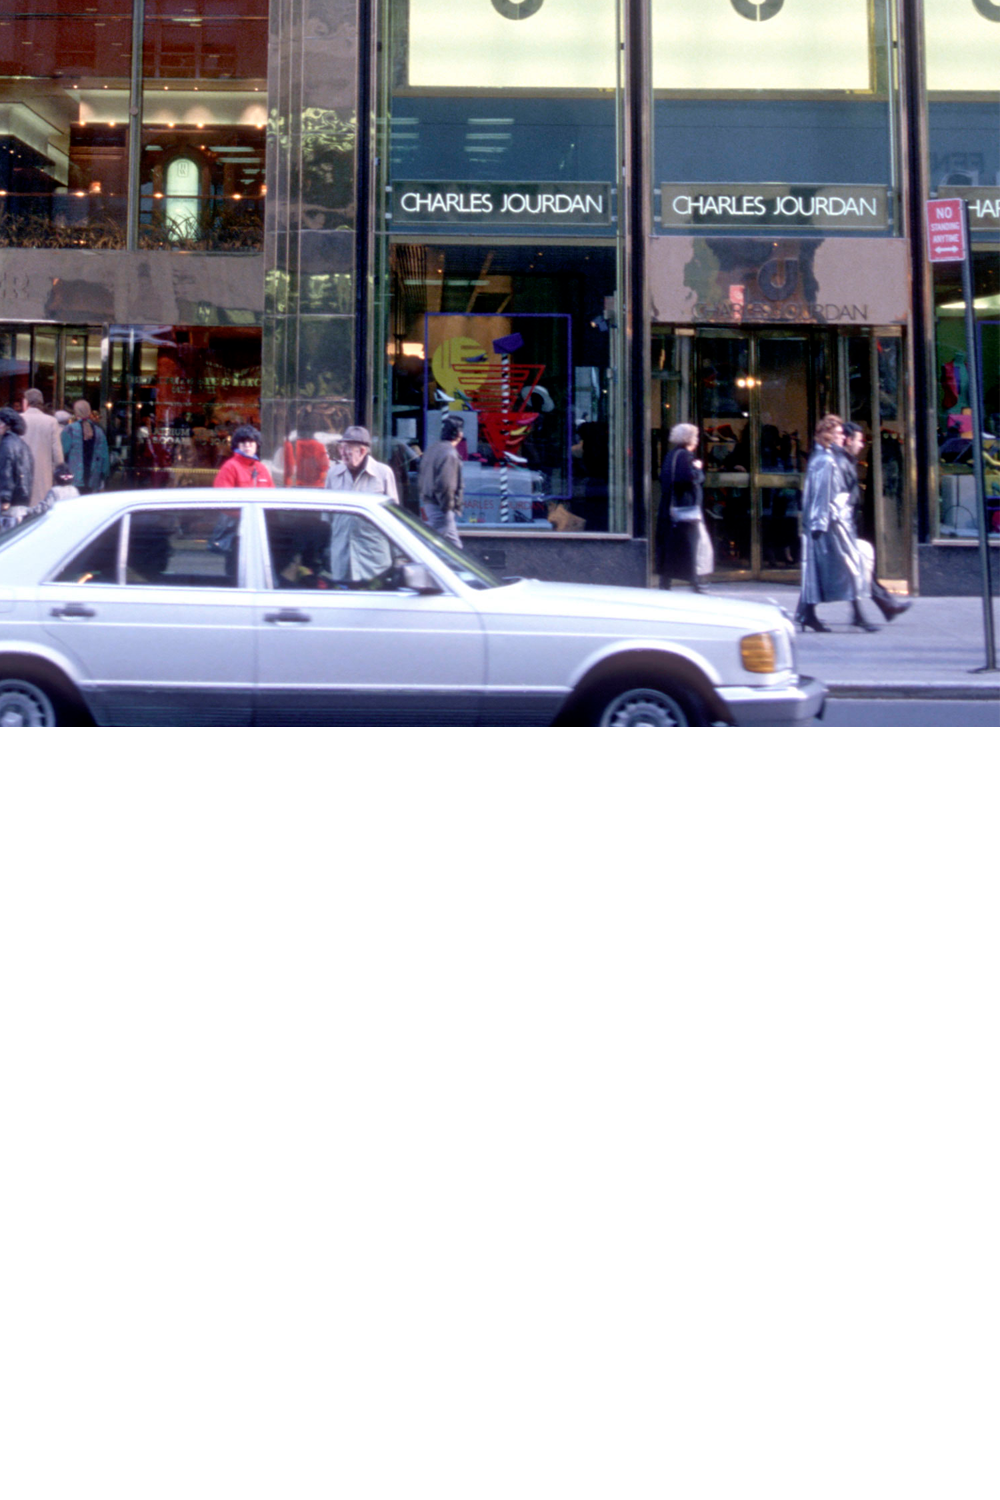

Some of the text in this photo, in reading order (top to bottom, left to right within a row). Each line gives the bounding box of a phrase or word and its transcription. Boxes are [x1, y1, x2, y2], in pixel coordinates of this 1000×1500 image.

[401, 192, 603, 213] CHARLES JOURDAN
[672, 195, 877, 216] CHARLES JOURDAN
[936, 206, 952, 219] NO
[930, 222, 960, 232] STANDING
[932, 234, 960, 244] ANYTIME
[691, 302, 868, 321] CHARLES JOURDAN
